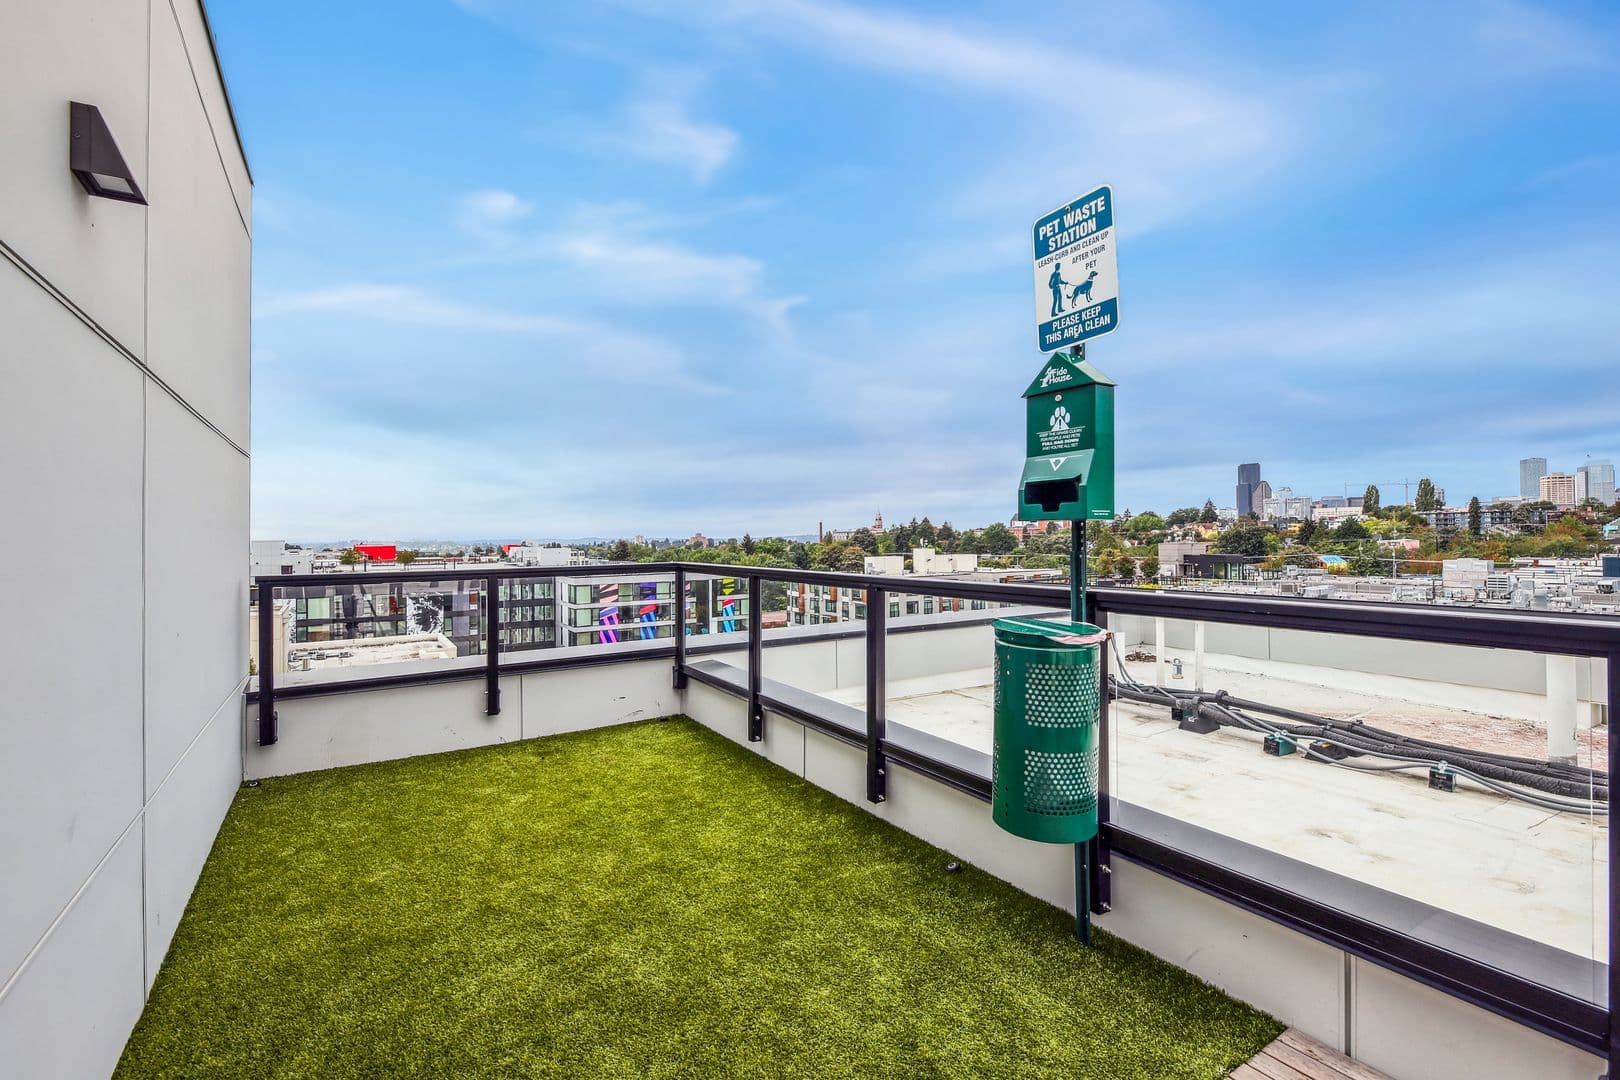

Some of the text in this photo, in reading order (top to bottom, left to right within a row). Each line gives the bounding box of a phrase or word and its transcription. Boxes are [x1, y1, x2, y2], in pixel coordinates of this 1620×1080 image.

[1039, 196, 1106, 241] PET WASTE
[1048, 217, 1097, 252] STATION
[1070, 243, 1081, 254] AND
[1081, 236, 1100, 249] CLEAN
[1100, 230, 1109, 240] UP
[1072, 244, 1106, 265] AFTER YOUR
[1085, 259, 1097, 270] PET
[1045, 313, 1111, 345] THIS AREA CLEAN
[1052, 305, 1102, 331] PLEASE KEEP
[1049, 374, 1073, 385] House
